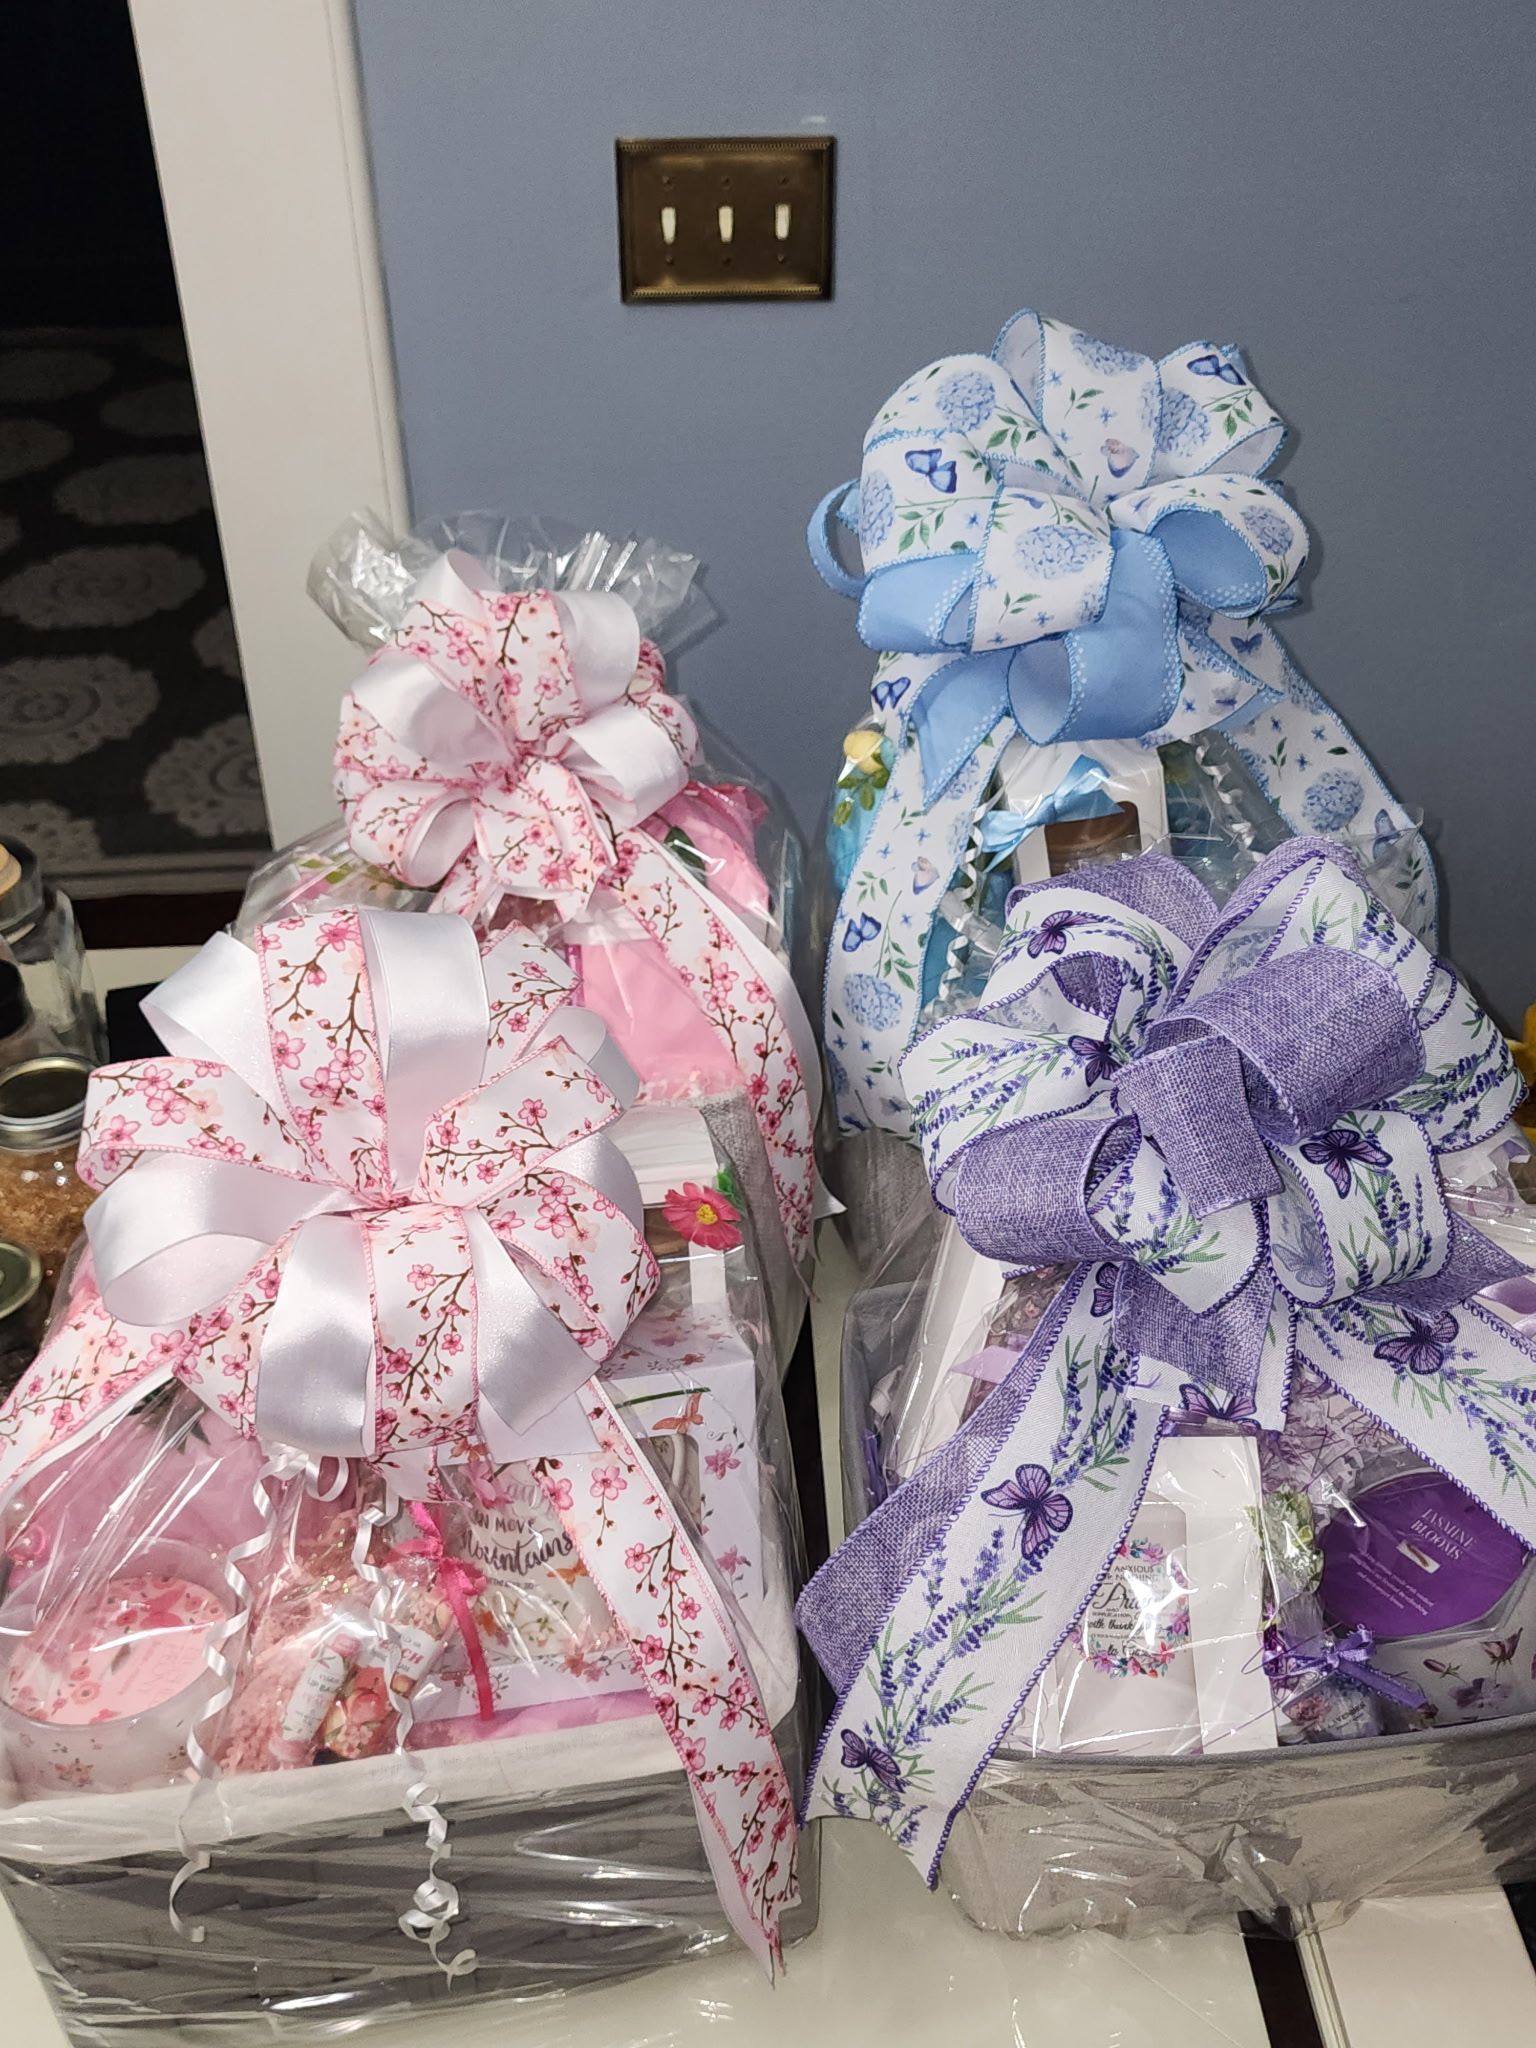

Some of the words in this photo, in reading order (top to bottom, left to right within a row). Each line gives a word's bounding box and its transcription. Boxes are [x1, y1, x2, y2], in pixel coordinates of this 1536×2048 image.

[1410, 1519, 1463, 1560] BLOOMS
[1421, 1508, 1478, 1549] JASMINE
[1114, 1565, 1154, 1573] ANXIOUS
